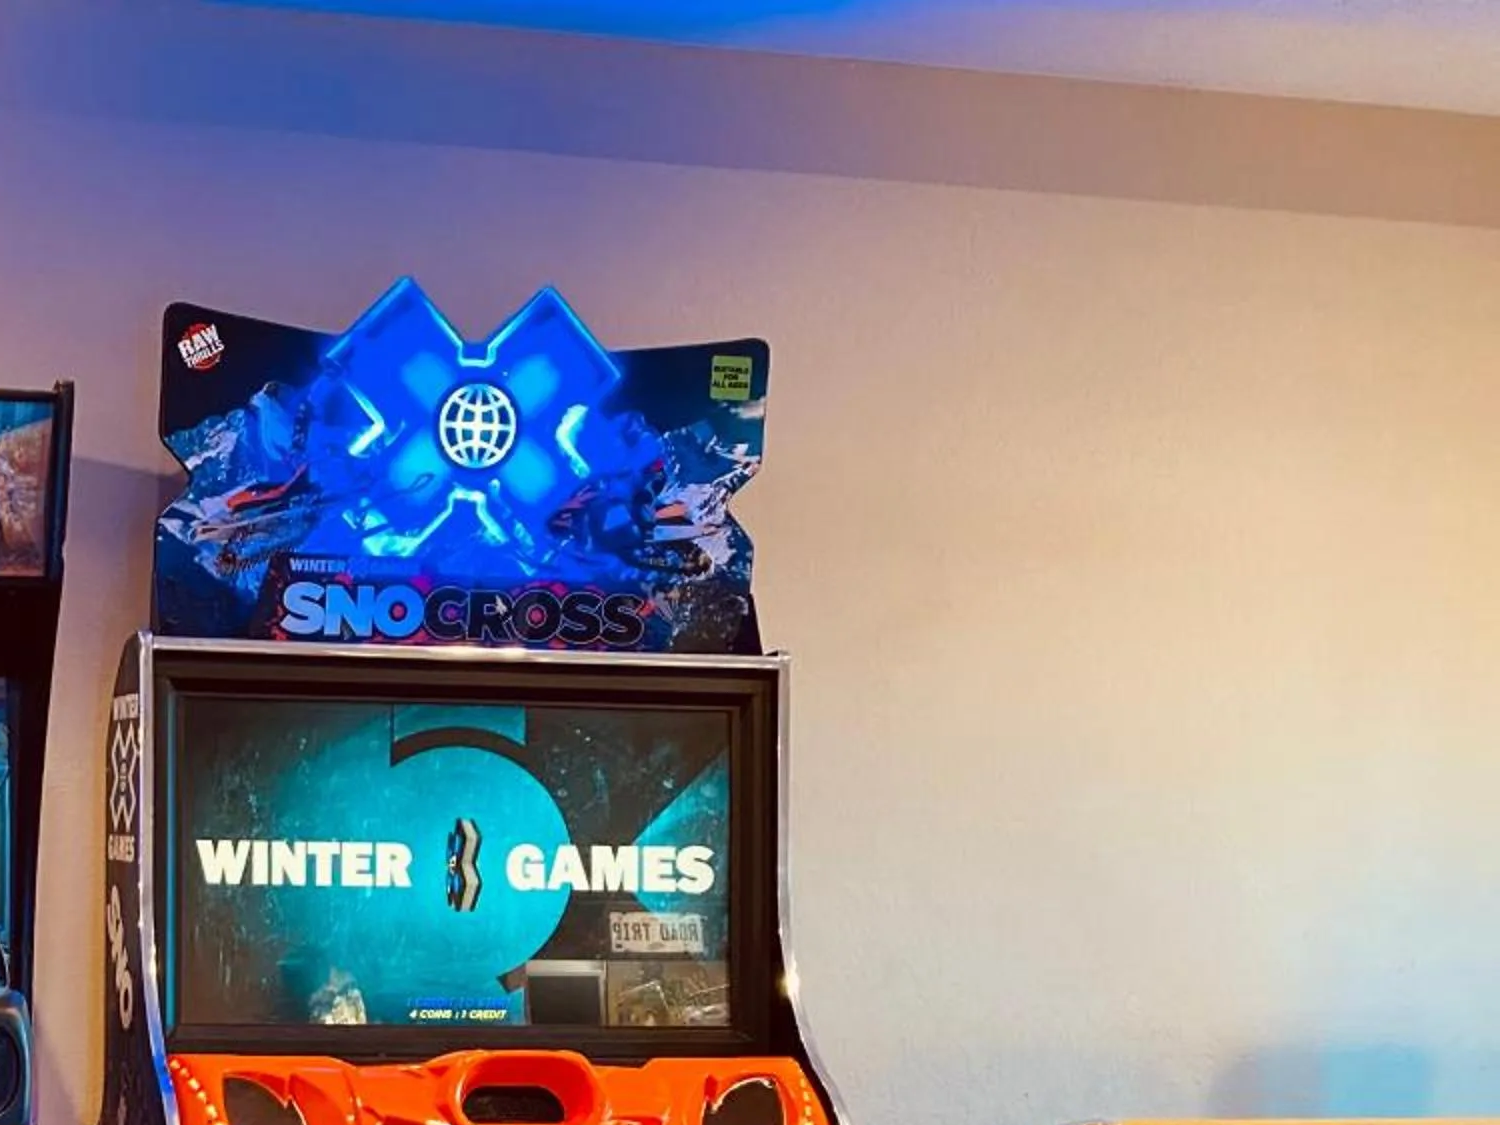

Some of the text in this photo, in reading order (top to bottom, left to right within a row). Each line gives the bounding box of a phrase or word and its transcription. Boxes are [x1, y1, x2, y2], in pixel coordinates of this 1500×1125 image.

[178, 323, 219, 358] RAW
[289, 557, 347, 574] WINTER
[279, 581, 646, 647] SNOCROSS
[196, 839, 716, 893] WINTER GAMES
[420, 1009, 453, 1020] COINS
